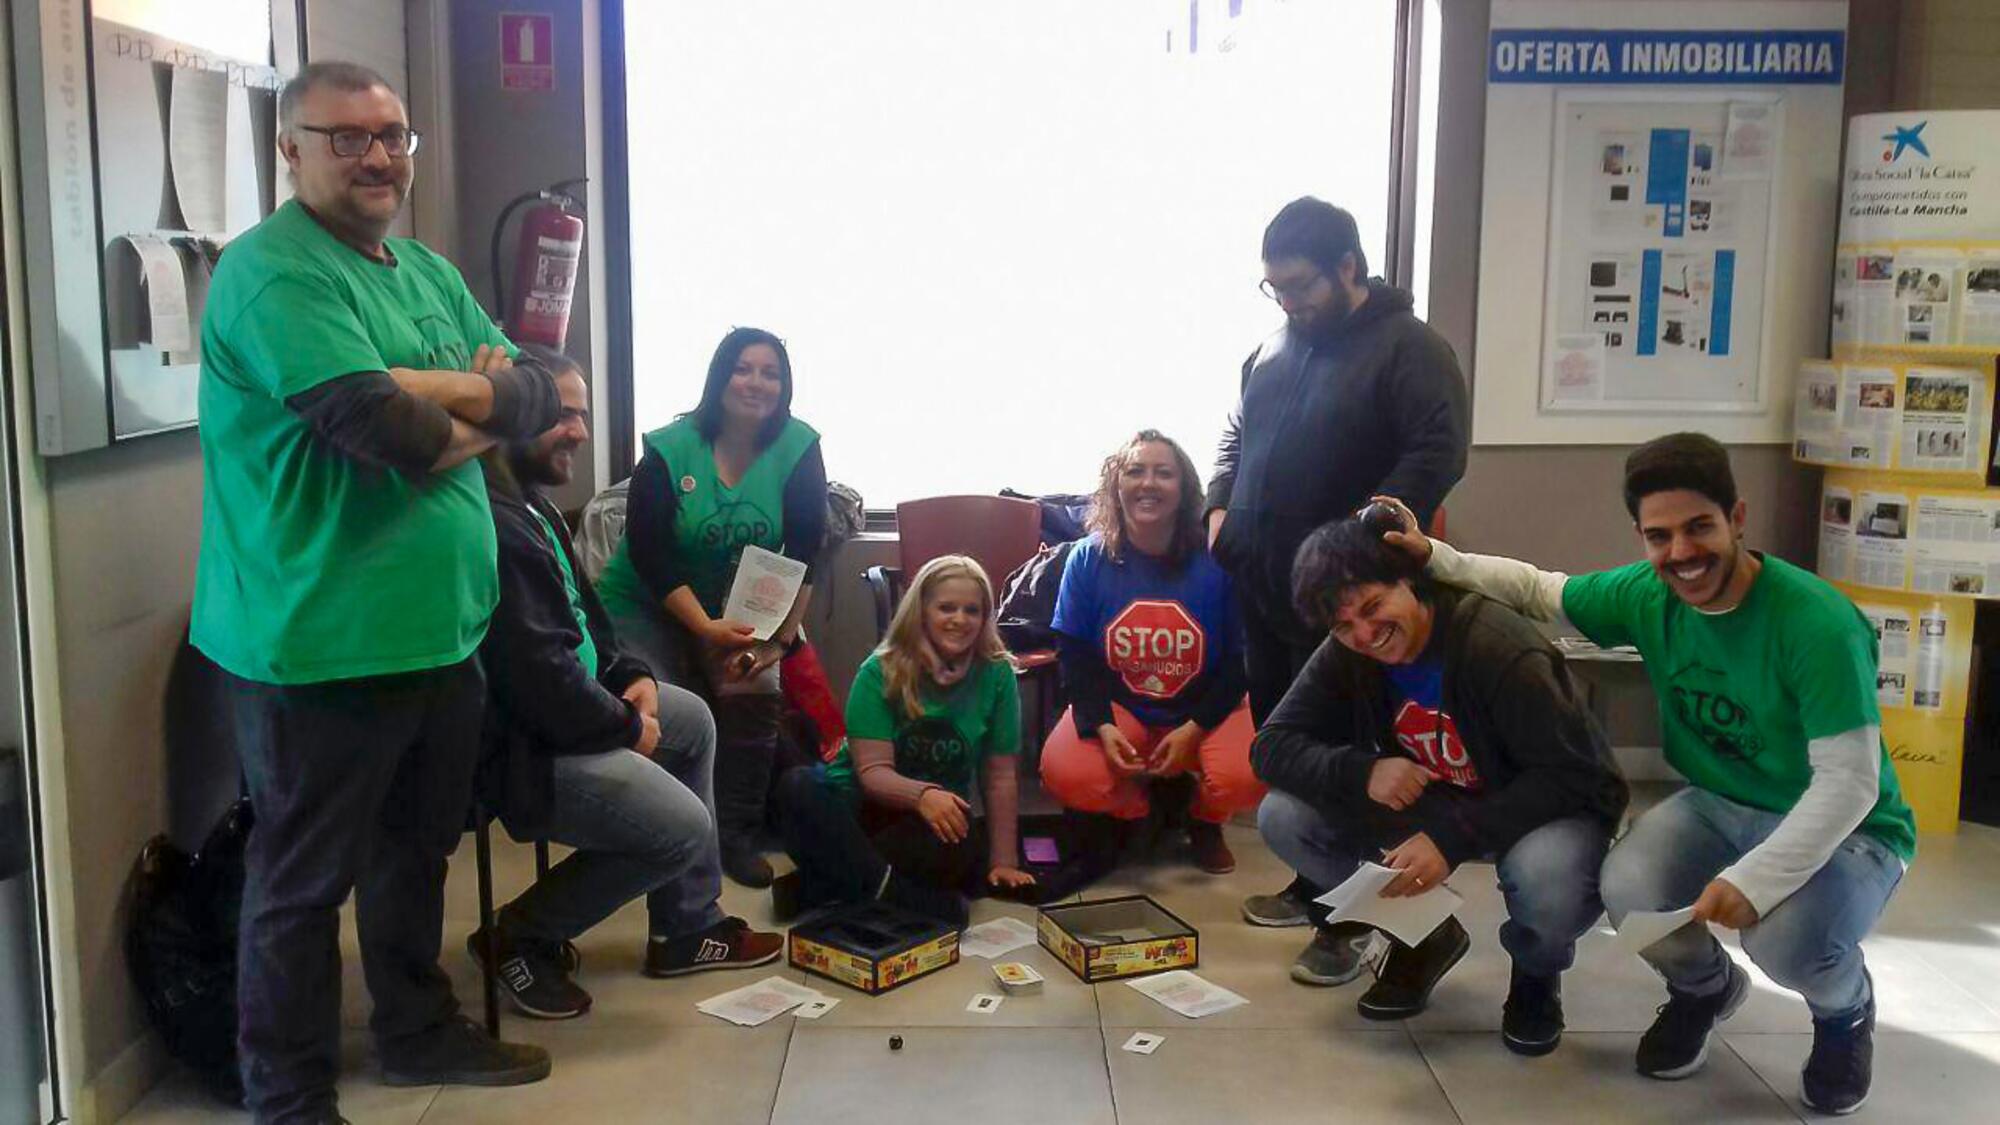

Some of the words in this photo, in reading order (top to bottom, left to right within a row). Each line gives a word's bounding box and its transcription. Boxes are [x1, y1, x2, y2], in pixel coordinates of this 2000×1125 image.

[1496, 41, 1611, 74] OFERTA
[1621, 42, 1834, 74] INMOBILIARIA
[1875, 166, 1912, 181] Social
[1945, 191, 1968, 201] con
[1913, 203, 1968, 216] Mancha
[704, 522, 769, 548] STOP
[1113, 625, 1195, 660] STOP
